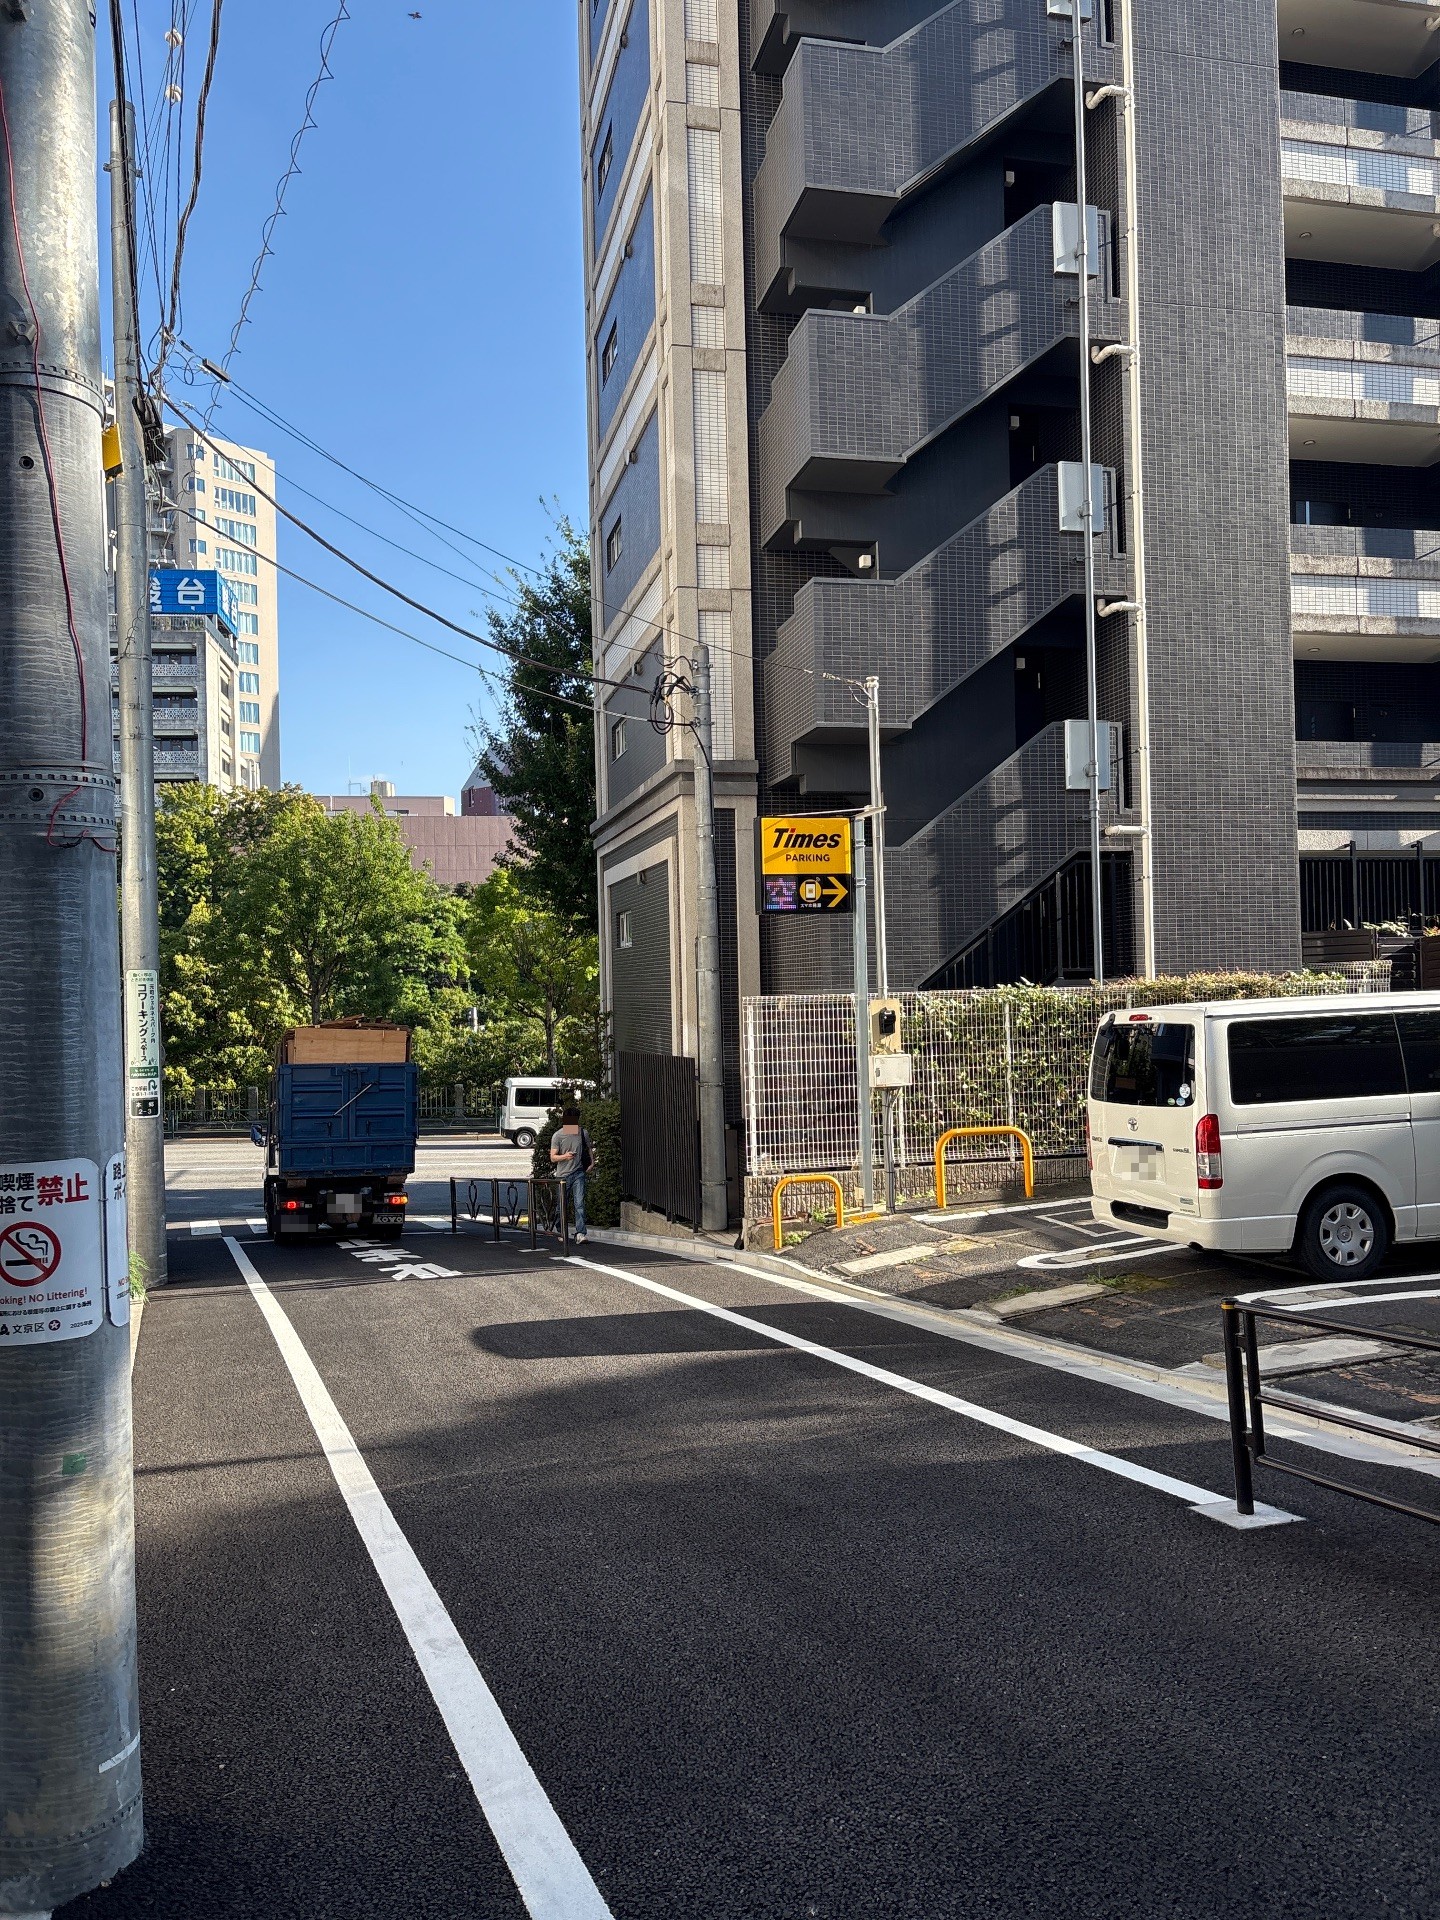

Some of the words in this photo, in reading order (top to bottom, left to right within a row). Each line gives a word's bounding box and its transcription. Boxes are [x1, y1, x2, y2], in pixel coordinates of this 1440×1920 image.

[772, 827, 842, 849] Times
[785, 853, 831, 862] PARKING
[765, 877, 797, 910] 空
[36, 1172, 90, 1207] 禁止
[0, 1195, 35, 1215] 捨て
[336, 1238, 463, 1281] 止まれ
[28, 1293, 45, 1303] NO
[46, 1286, 88, 1301] Littering!
[12, 1321, 45, 1335] 文京区
